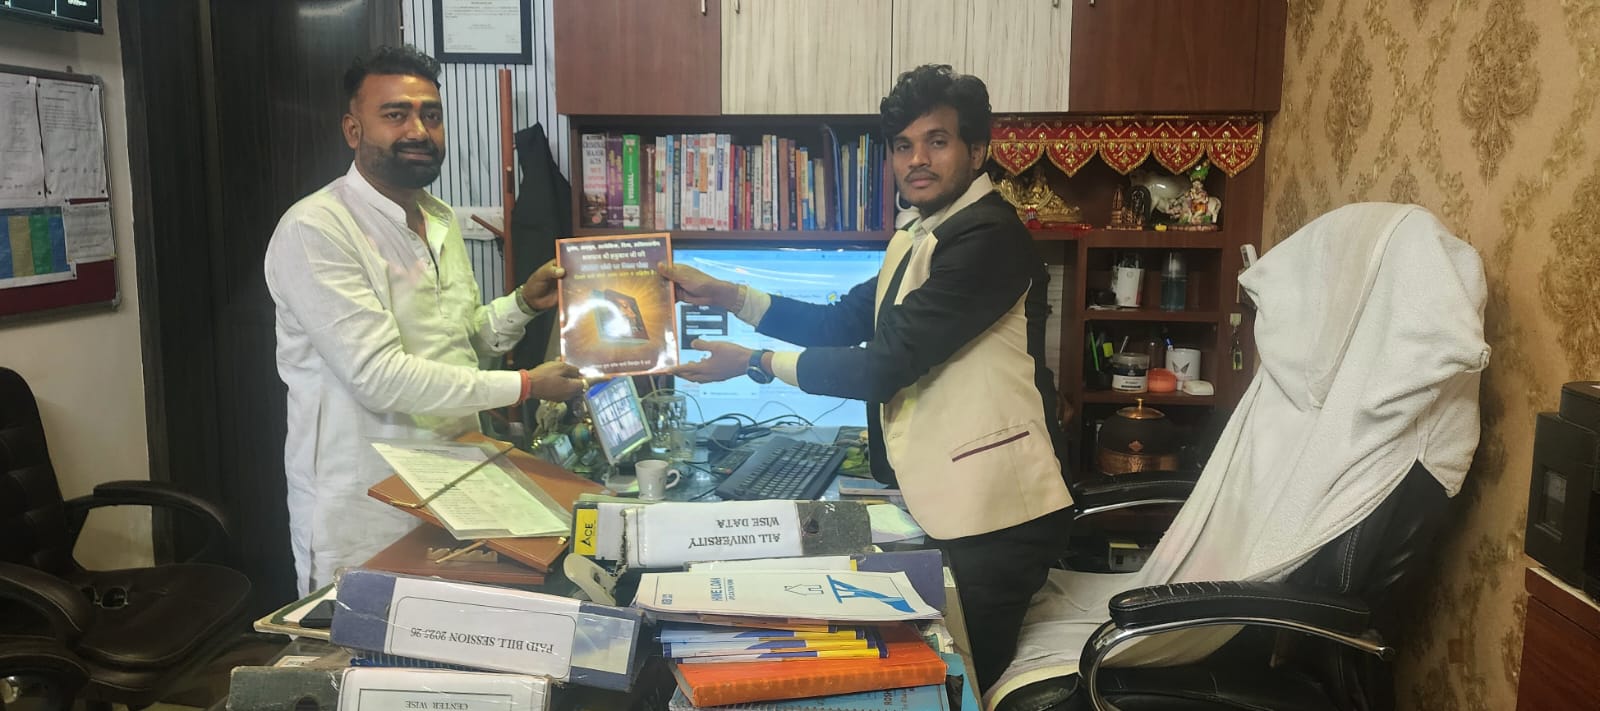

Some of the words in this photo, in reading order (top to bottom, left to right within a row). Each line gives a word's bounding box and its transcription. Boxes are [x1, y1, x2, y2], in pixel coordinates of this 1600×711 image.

[717, 518, 749, 528] DATA
[753, 517, 780, 527] WISE
[581, 523, 594, 547] ACE
[760, 533, 780, 543] ALL
[688, 535, 756, 549] UNIVERSITY
[448, 633, 496, 646] SESSION
[499, 637, 525, 650] BILL
[526, 640, 555, 654] PAID
[405, 700, 428, 710] WISE
[432, 702, 469, 711] CENTER
